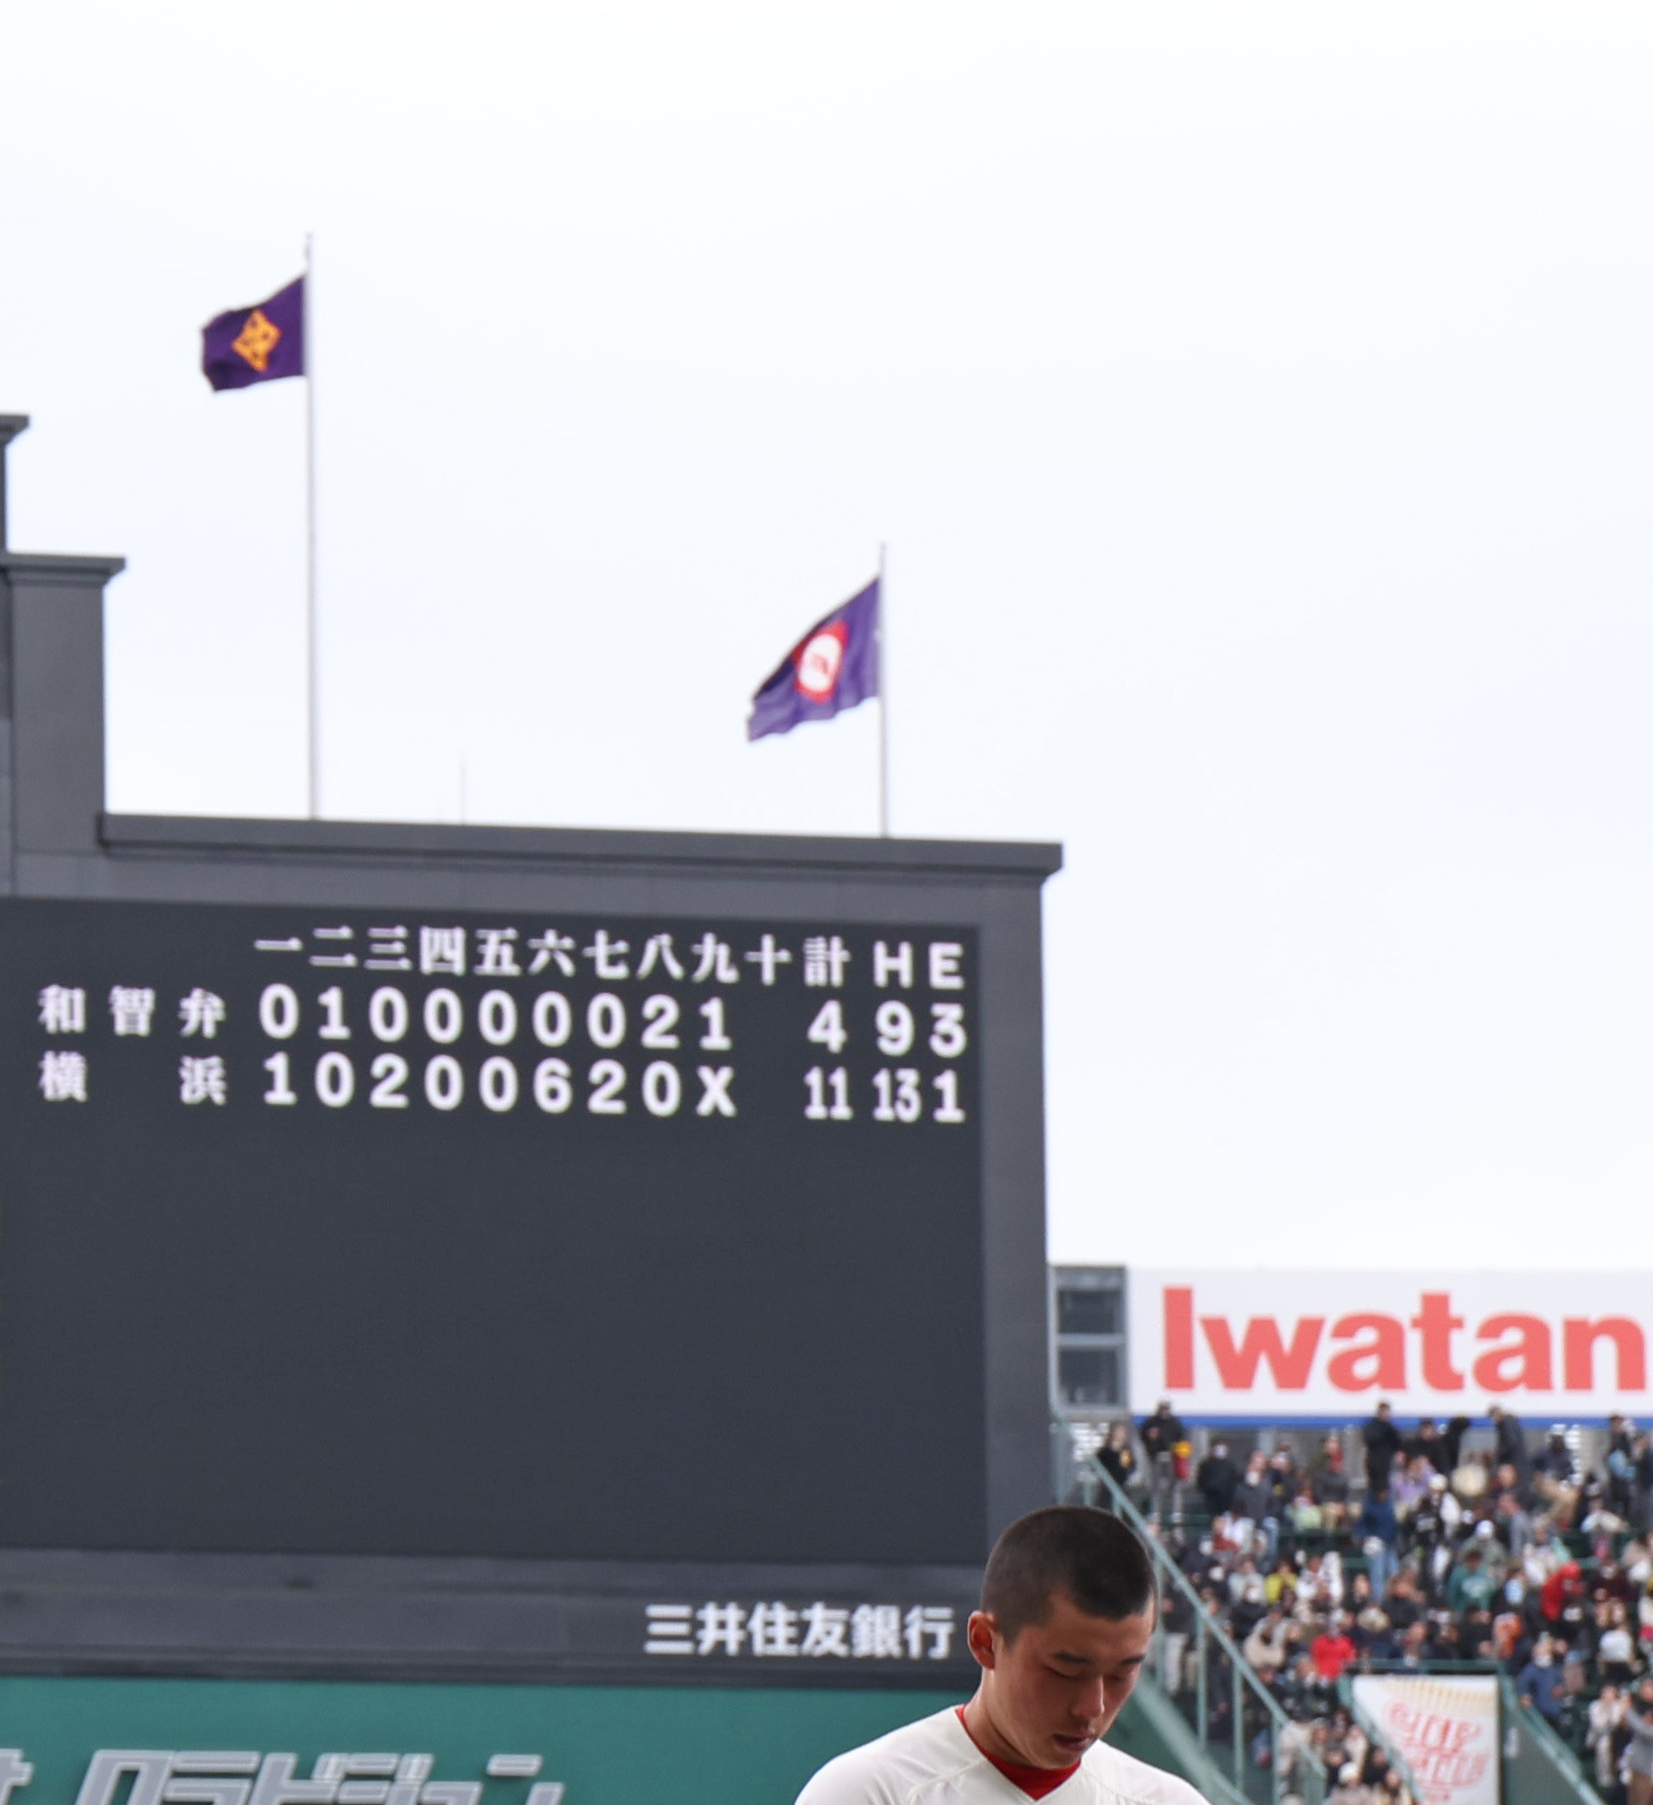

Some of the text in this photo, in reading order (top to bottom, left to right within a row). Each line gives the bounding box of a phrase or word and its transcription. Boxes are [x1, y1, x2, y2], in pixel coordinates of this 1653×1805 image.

[1163, 1286, 1647, 1393] Iwatan
[644, 1600, 955, 1660] 三井住友銀行
